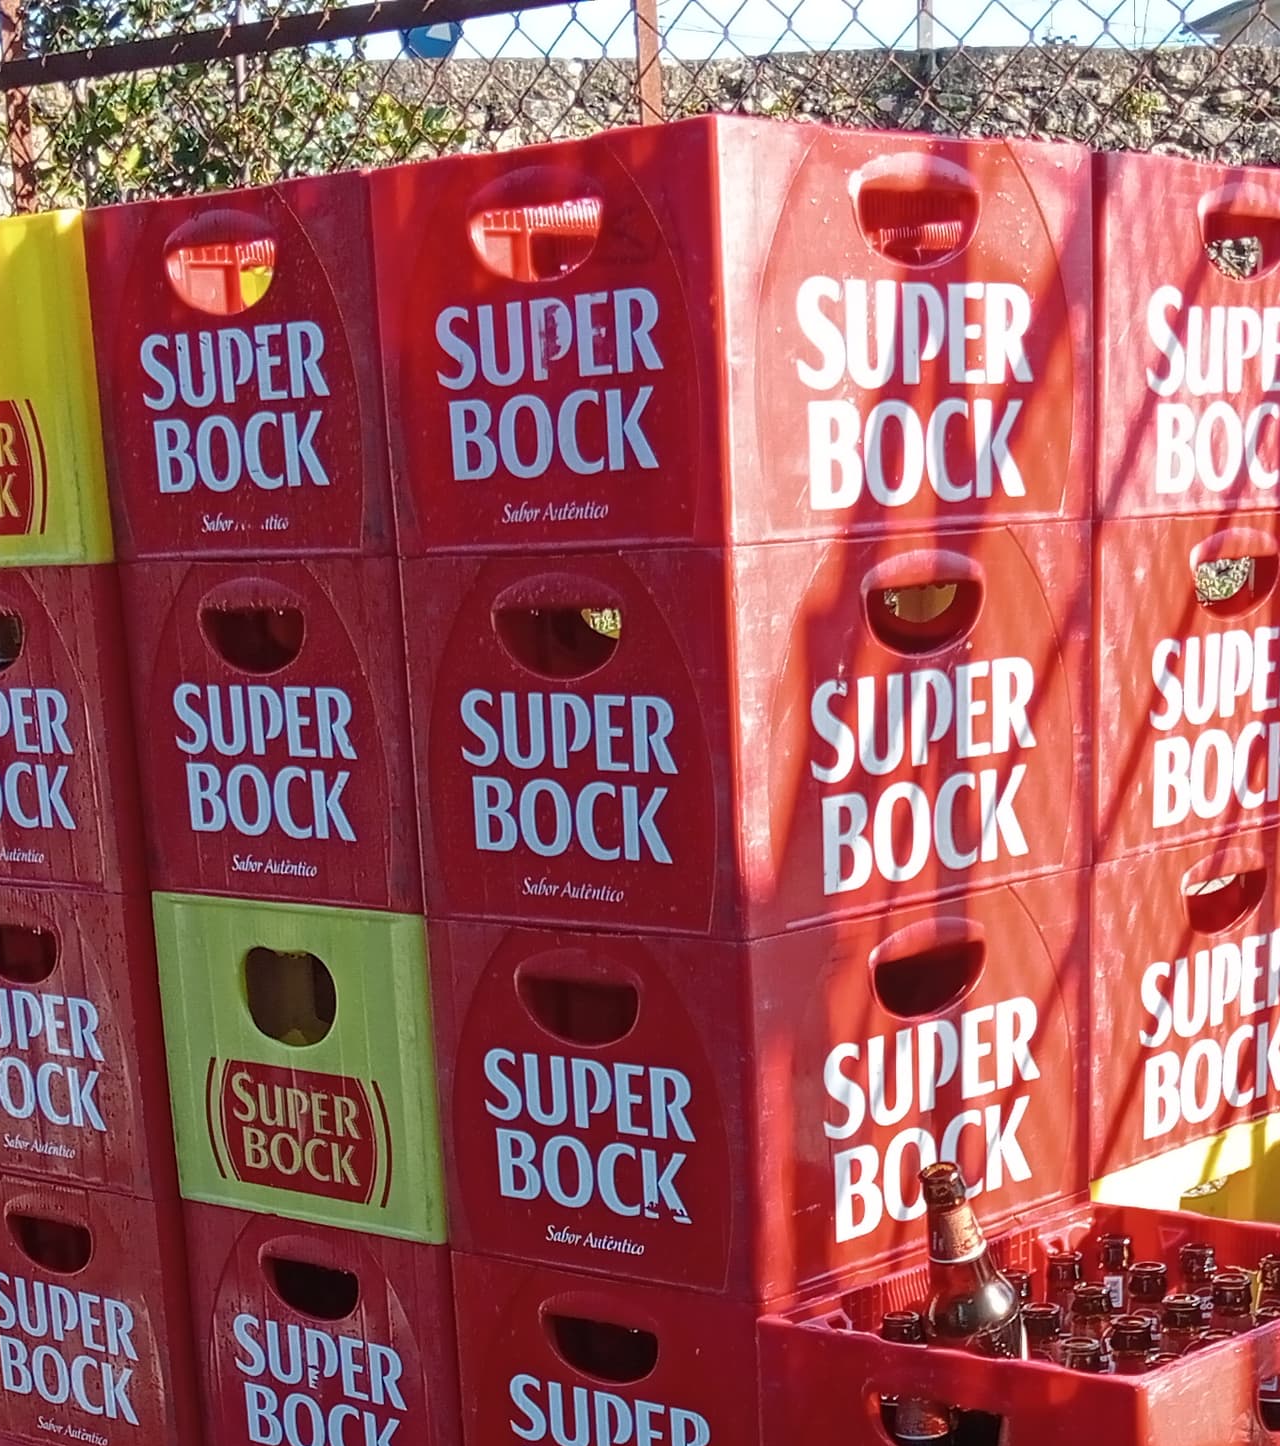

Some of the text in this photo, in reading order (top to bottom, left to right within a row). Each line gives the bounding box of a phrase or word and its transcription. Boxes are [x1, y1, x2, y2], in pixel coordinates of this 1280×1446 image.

[140, 321, 330, 411] SUPER
[435, 289, 664, 390] SUPER
[795, 276, 1033, 391] SUPER
[152, 410, 330, 493] BOCK
[448, 386, 659, 481] BOCK
[807, 399, 1025, 510] BOCK
[201, 512, 234, 533] Sabor
[502, 501, 608, 525] Sabor Autêntico
[173, 682, 358, 759] SUPER
[460, 689, 678, 774] SUPER
[810, 656, 1037, 783] SUPER
[186, 763, 358, 842] BOCK
[472, 776, 673, 865] BOCK
[822, 764, 1029, 896] BOCK
[232, 854, 318, 877] Sabor Autêntico
[522, 876, 624, 903] Sabor Autêntico
[232, 1071, 362, 1139] SUPER
[483, 1048, 696, 1142] SUPER
[823, 996, 1040, 1140] SUPER
[242, 1126, 361, 1187] BOCK
[496, 1127, 692, 1225] BOCK
[834, 1096, 1033, 1243] BOCK
[546, 1224, 644, 1255] Sabor Autêntico
[233, 1313, 407, 1411] SUPER
[37, 1414, 63, 1436] Sabor
